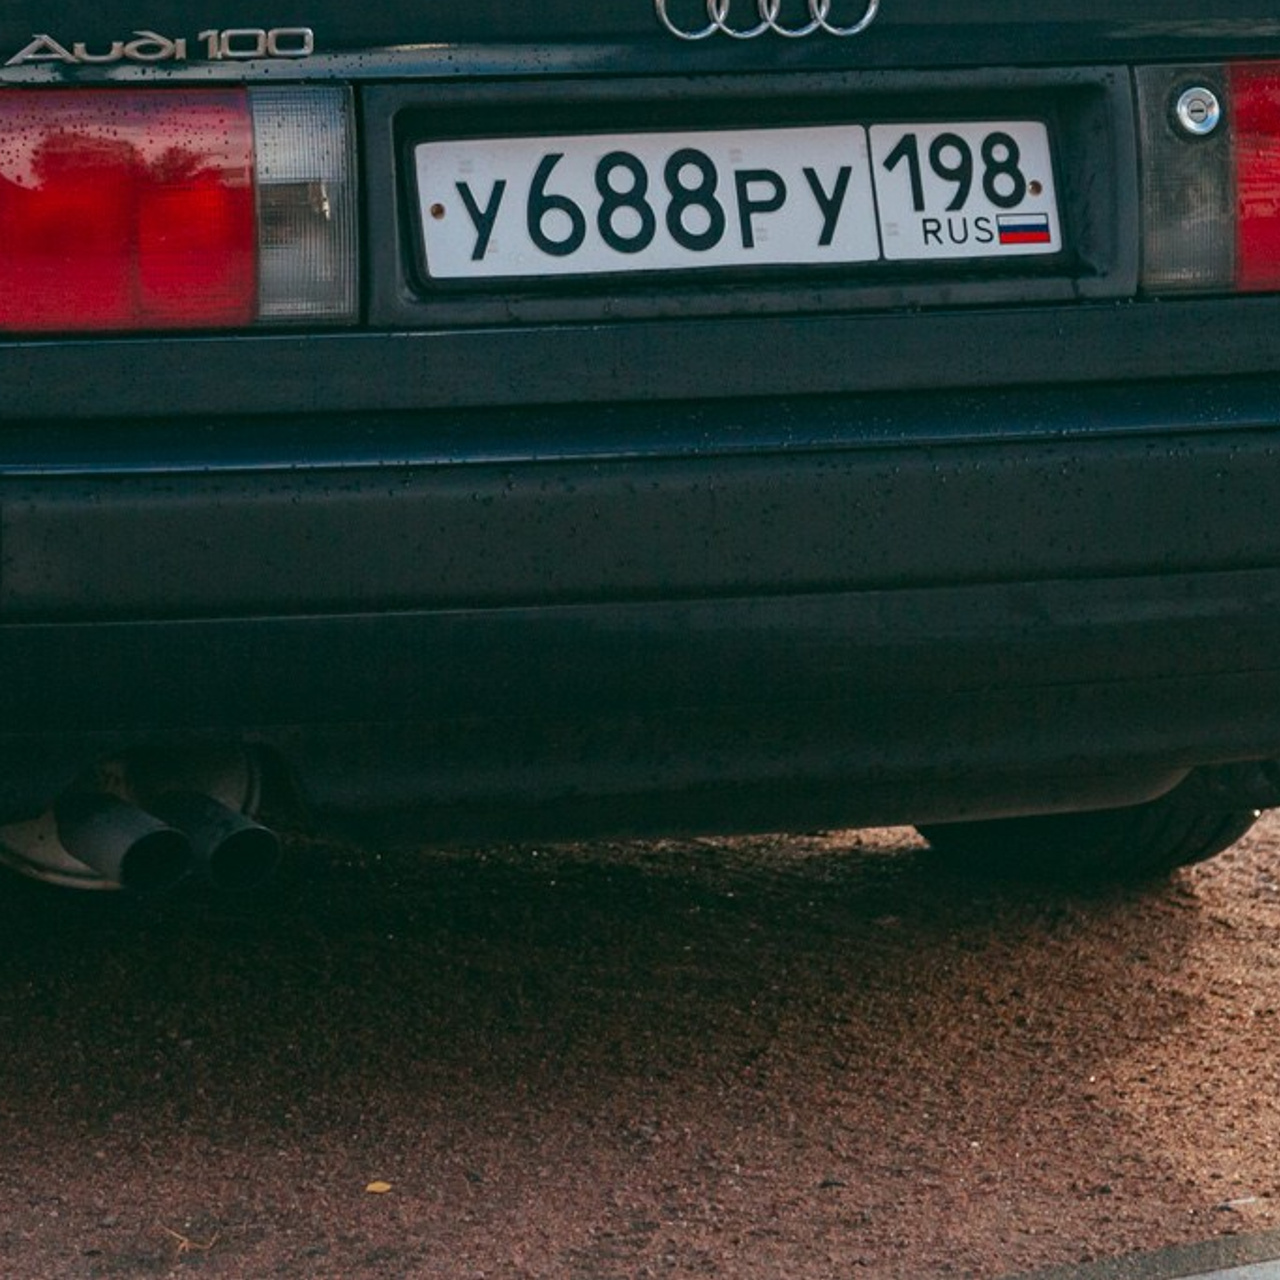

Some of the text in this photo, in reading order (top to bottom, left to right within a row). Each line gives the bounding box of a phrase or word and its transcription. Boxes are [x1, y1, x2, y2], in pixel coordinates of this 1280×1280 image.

[3, 27, 315, 65] Audi 100
[882, 131, 1027, 212] 198
[922, 216, 995, 246] RUS
